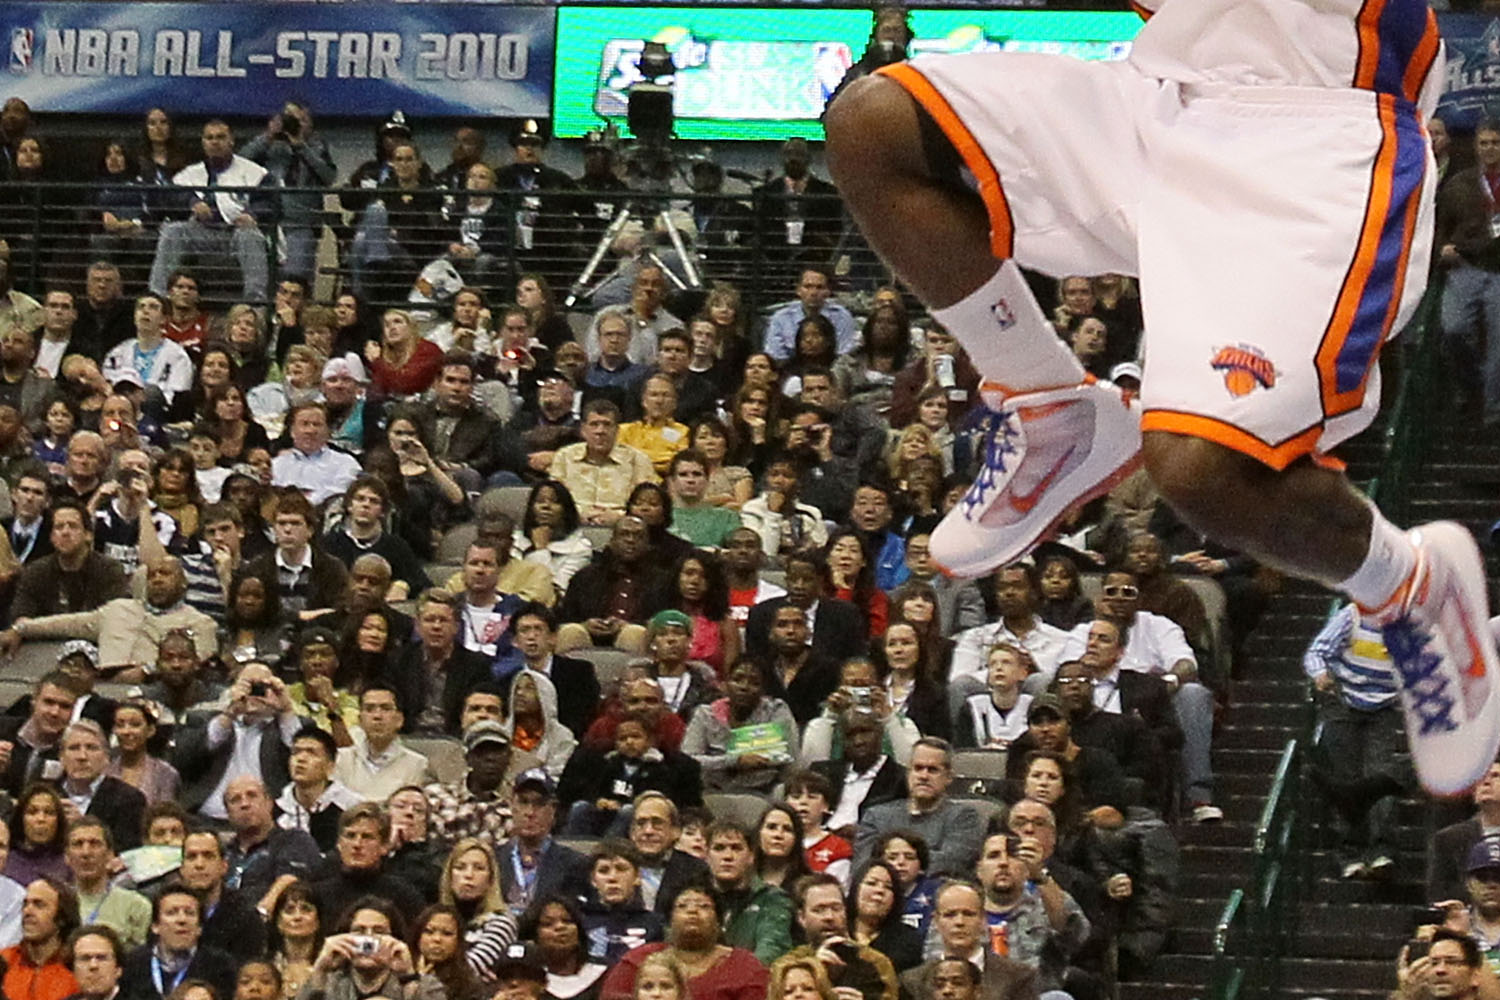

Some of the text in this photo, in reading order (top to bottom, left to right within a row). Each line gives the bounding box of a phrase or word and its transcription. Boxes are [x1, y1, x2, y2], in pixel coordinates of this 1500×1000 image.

[43, 28, 530, 82] NBA ALL-STAR 2010
